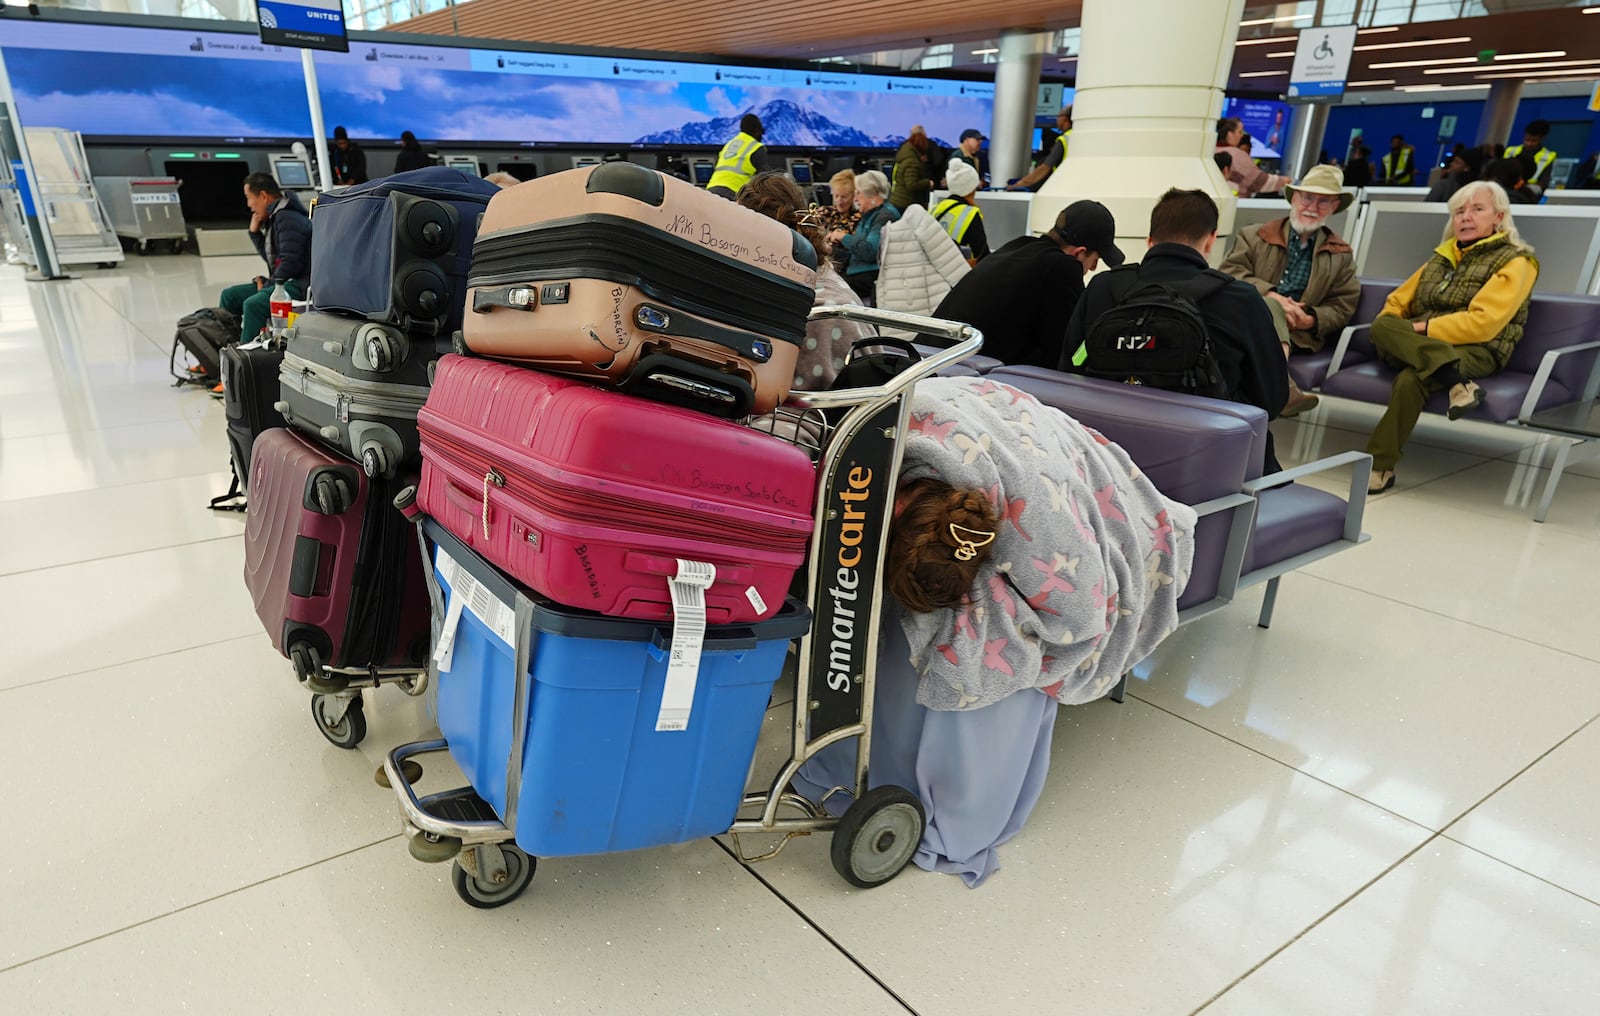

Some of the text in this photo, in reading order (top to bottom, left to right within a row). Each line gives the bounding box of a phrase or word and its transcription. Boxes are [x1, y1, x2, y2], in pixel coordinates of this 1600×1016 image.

[306, 10, 340, 22] UNITED
[132, 194, 168, 202] UNITED
[698, 222, 750, 258] Basargin
[752, 245, 778, 266] Santa
[779, 255, 803, 276] Cruz
[772, 488, 799, 508] Cruz
[826, 465, 873, 694] smartecarte
